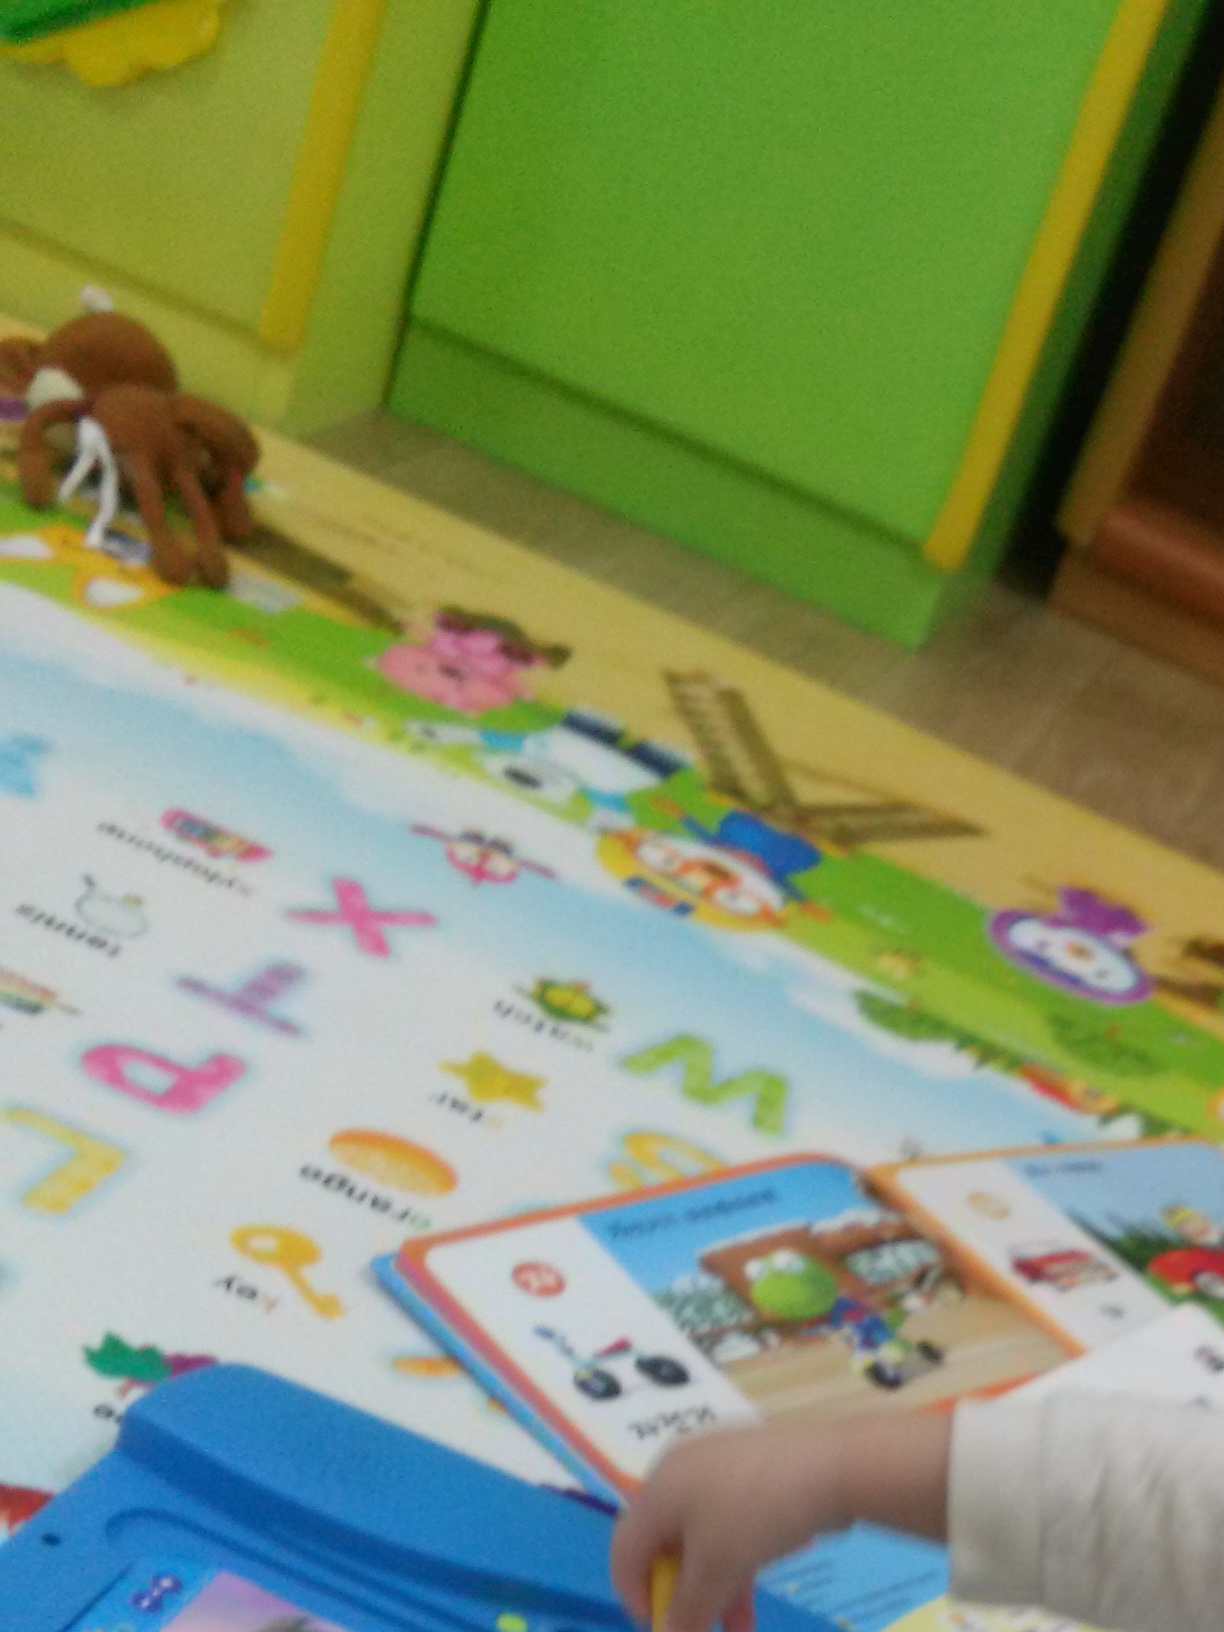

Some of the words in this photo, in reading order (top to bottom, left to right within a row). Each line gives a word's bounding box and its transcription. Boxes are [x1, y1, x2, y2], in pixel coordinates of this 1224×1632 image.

[285, 876, 437, 958] X
[174, 960, 306, 1036] T
[80, 1042, 247, 1116] P
[618, 1032, 790, 1140] W
[2, 1106, 126, 1216] L
